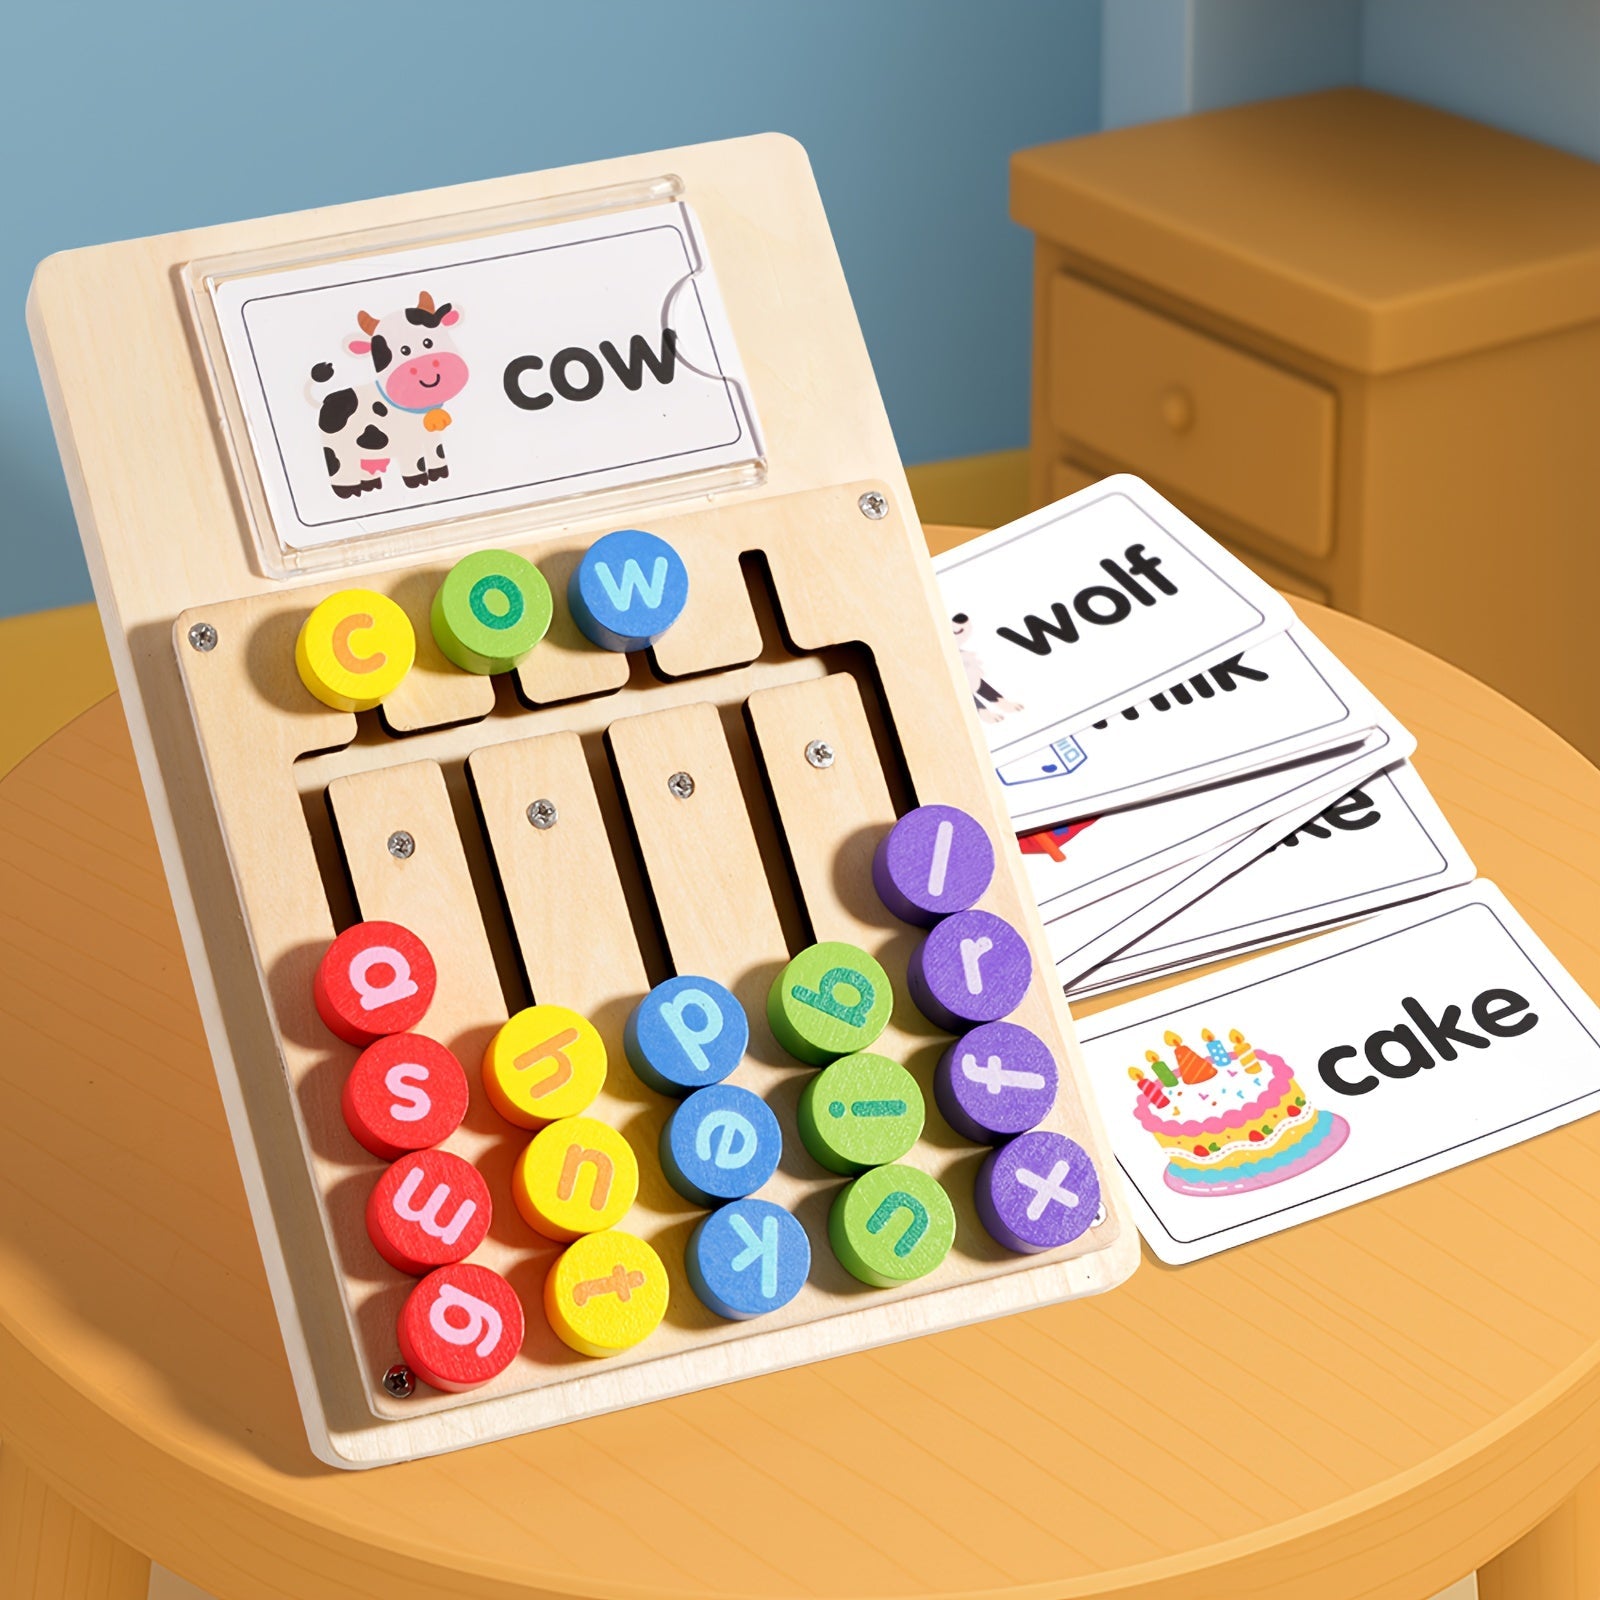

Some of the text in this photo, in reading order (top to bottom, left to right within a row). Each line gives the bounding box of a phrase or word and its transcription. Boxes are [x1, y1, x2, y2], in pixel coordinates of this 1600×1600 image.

[503, 328, 678, 411] cow
[331, 556, 669, 675] c o w
[996, 543, 1178, 656] wolf
[348, 945, 419, 1011] a
[959, 936, 994, 996] r
[512, 1027, 579, 1100] h
[961, 1053, 1046, 1095] f
[1317, 988, 1539, 1096] cake
[384, 1062, 432, 1122] s
[828, 1099, 907, 1119] i
[695, 1109, 758, 1170] e
[392, 1166, 477, 1246] m
[1014, 1159, 1080, 1221] x
[572, 1264, 646, 1308] t
[728, 1213, 779, 1299] k
[429, 1283, 503, 1358] g
